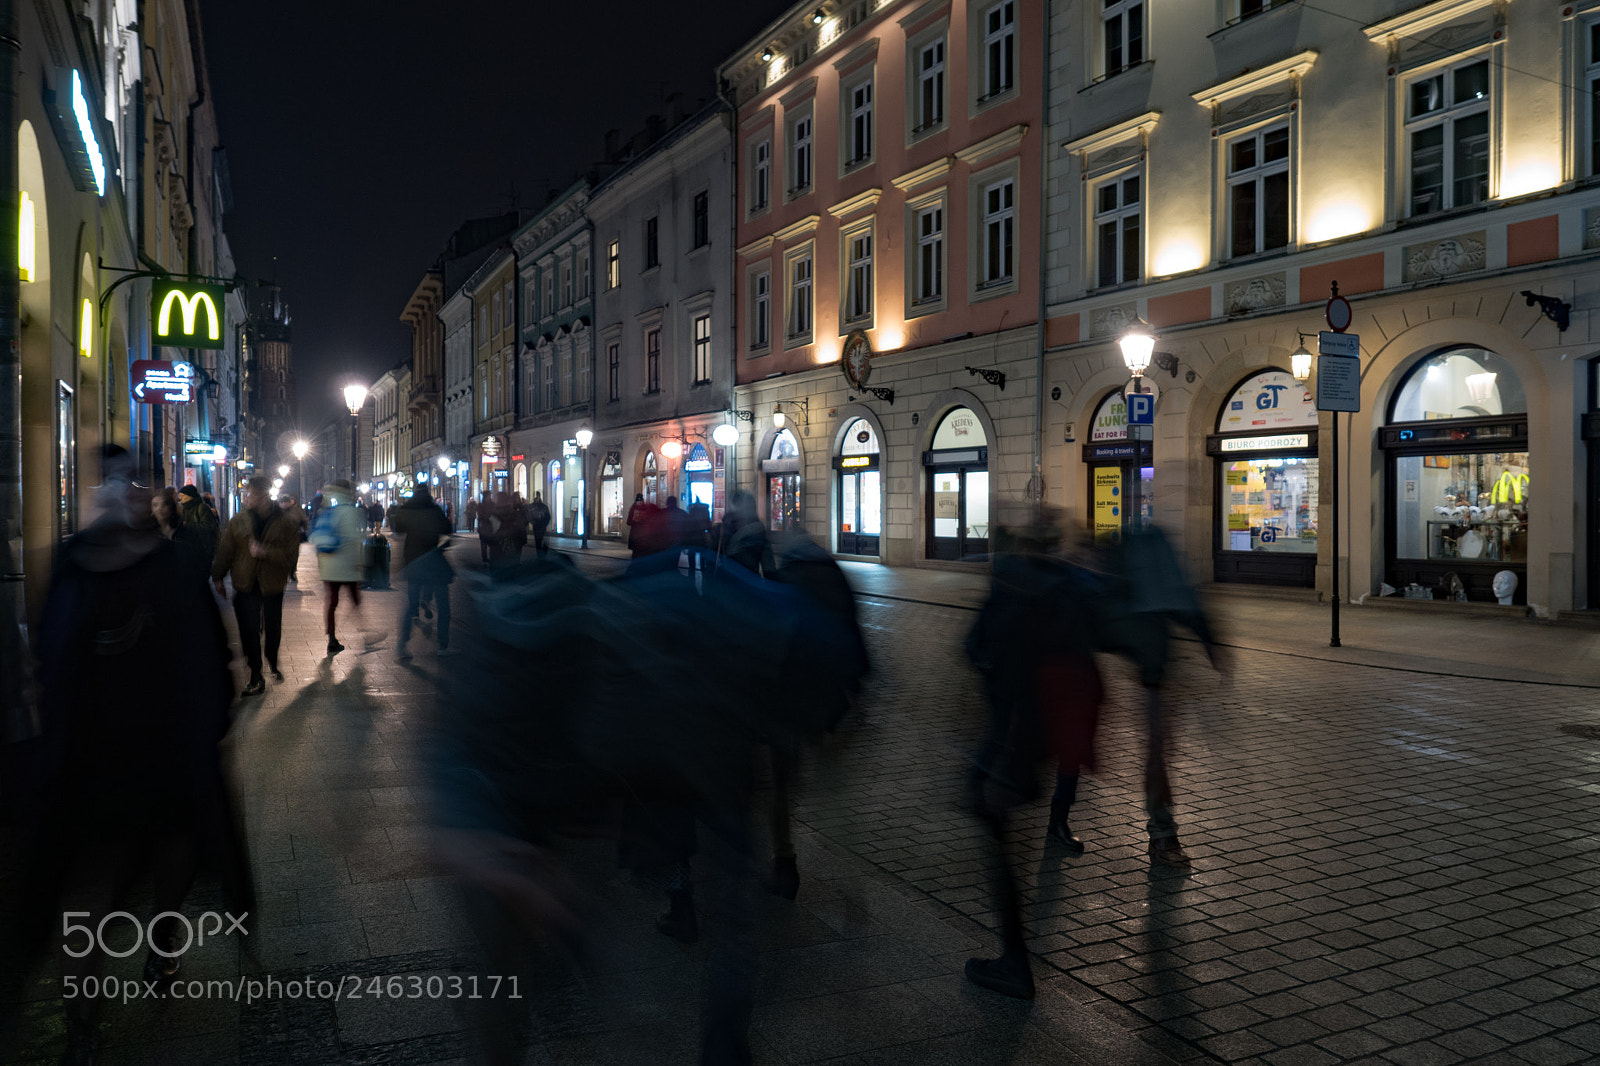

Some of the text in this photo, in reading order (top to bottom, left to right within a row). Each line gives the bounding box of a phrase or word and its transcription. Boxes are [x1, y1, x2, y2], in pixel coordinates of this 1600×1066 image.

[1256, 385, 1288, 410] GT
[1133, 397, 1149, 422] P
[1098, 415, 1127, 427] LUNC
[1227, 441, 1255, 449] BIURO
[1096, 448, 1113, 456] Booking
